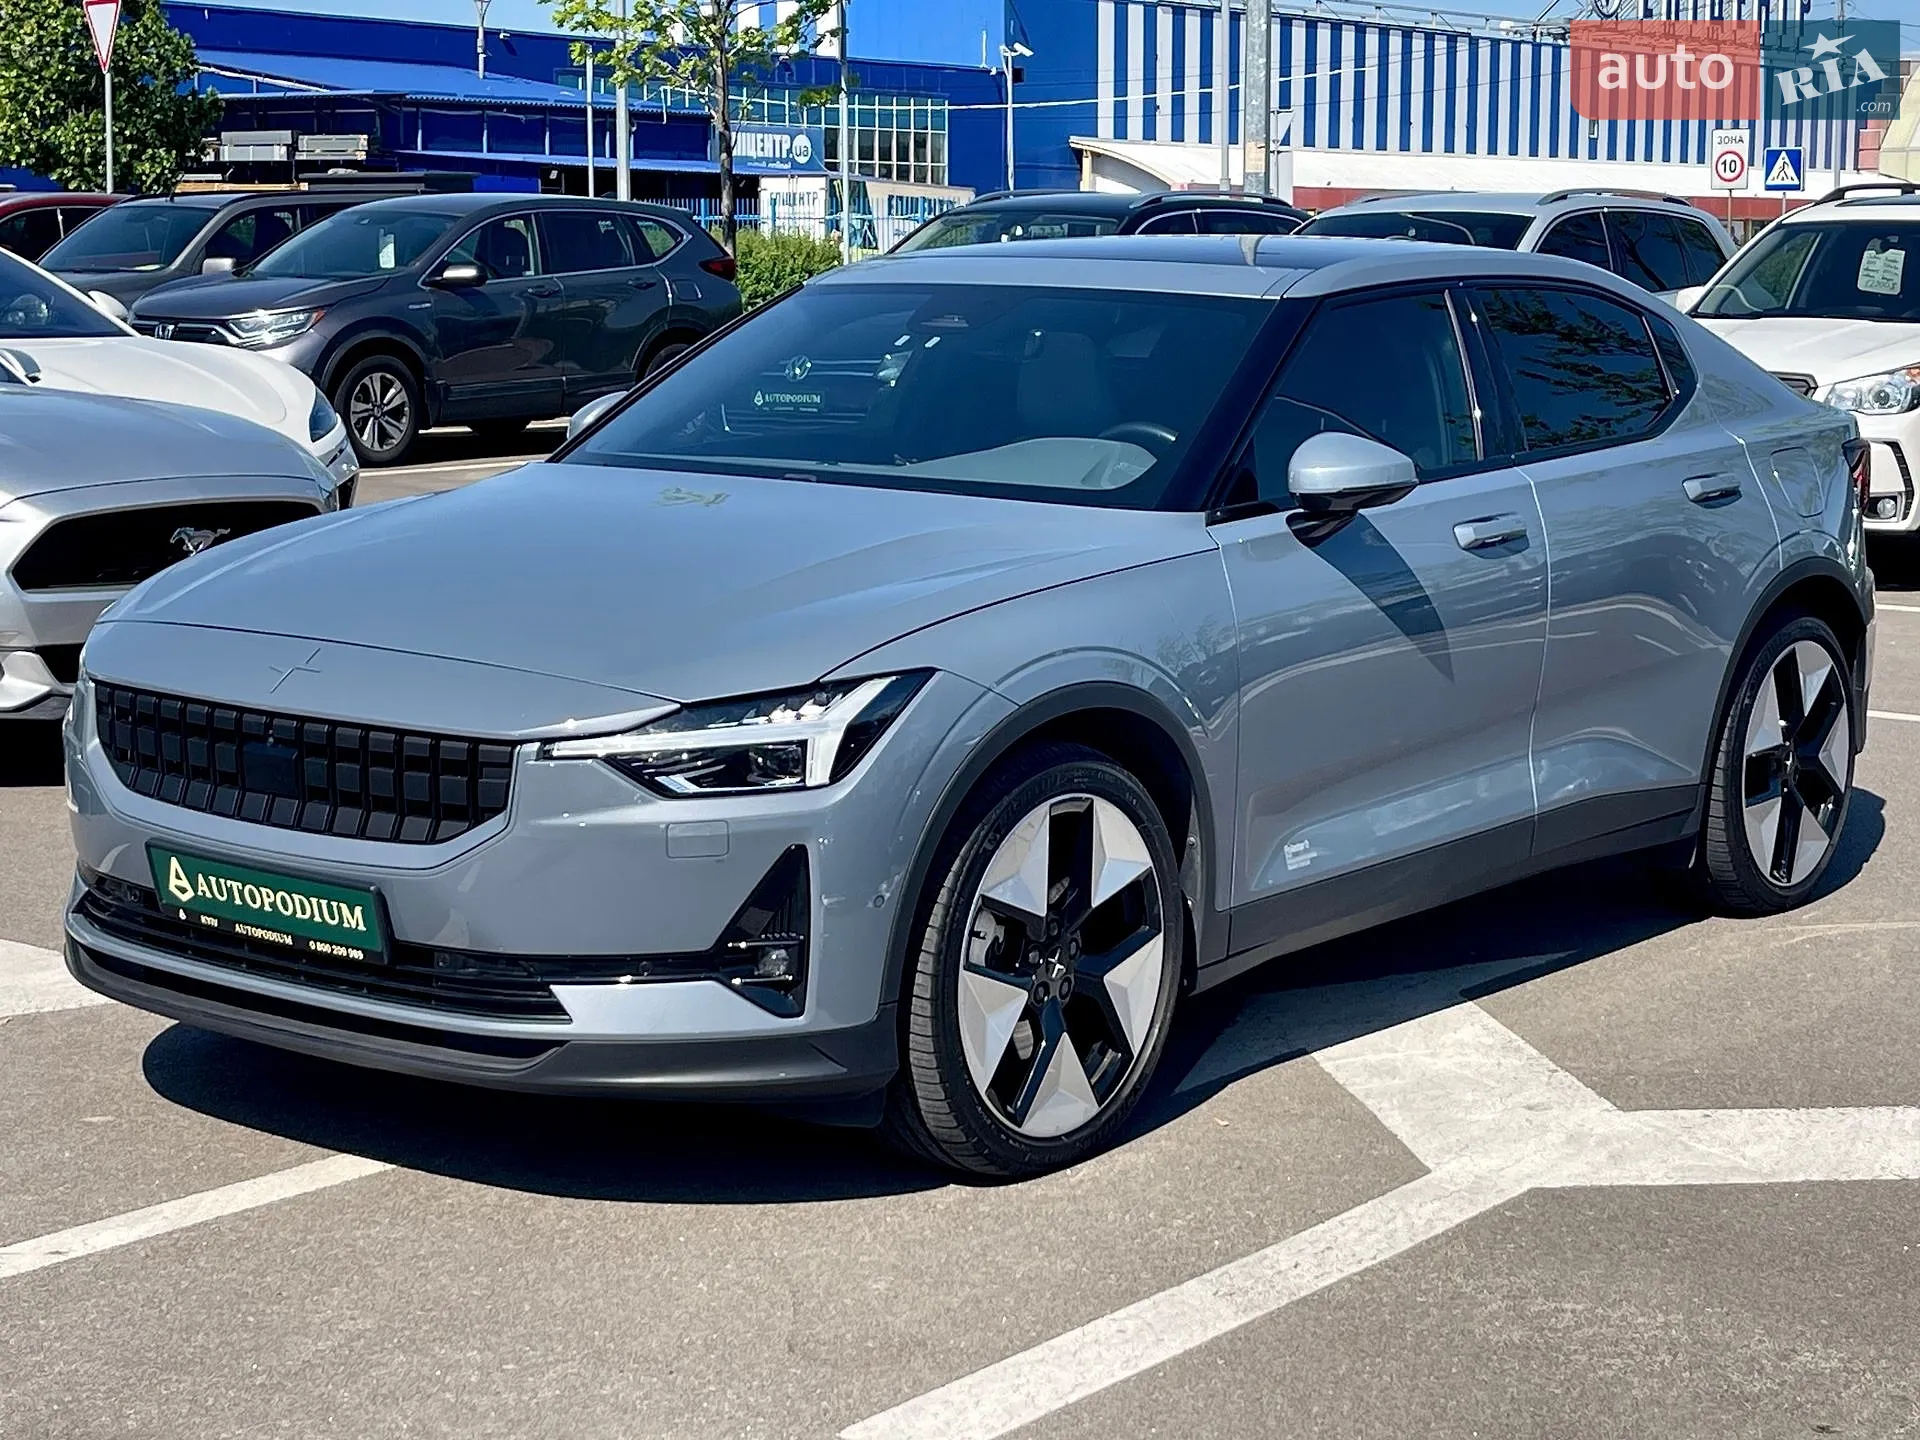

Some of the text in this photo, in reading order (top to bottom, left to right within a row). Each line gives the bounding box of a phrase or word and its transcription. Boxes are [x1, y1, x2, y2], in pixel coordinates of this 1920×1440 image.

[1716, 135, 1745, 145] ЗОНА
[1720, 158, 1738, 174] 10
[196, 873, 368, 932] AUTOPODIUM
[234, 922, 294, 946] AUTOPODIUM
